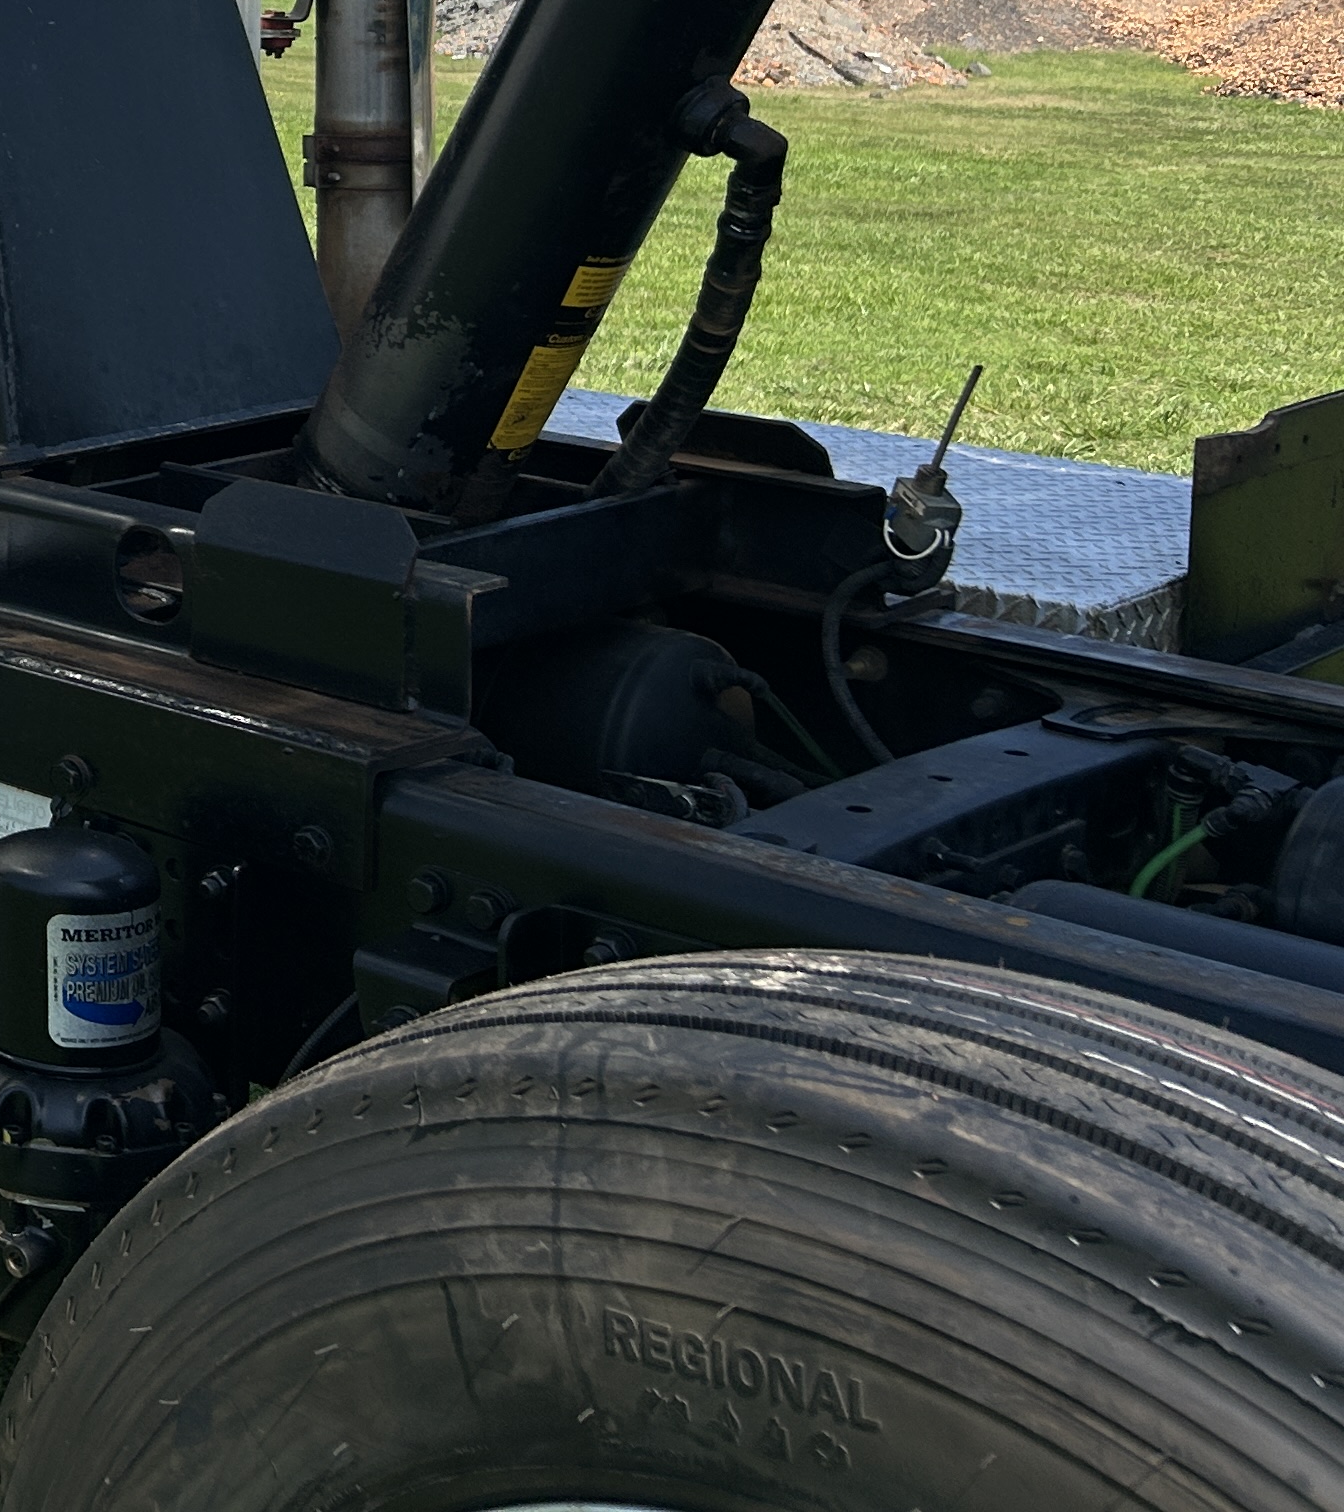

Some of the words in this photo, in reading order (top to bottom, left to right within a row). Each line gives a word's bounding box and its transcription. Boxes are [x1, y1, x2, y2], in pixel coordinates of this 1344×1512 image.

[60, 918, 154, 943] MERITOR
[65, 950, 129, 977] SYSTEM
[66, 978, 130, 1003] PREMIUM
[602, 1306, 884, 1433] REGIONAL
